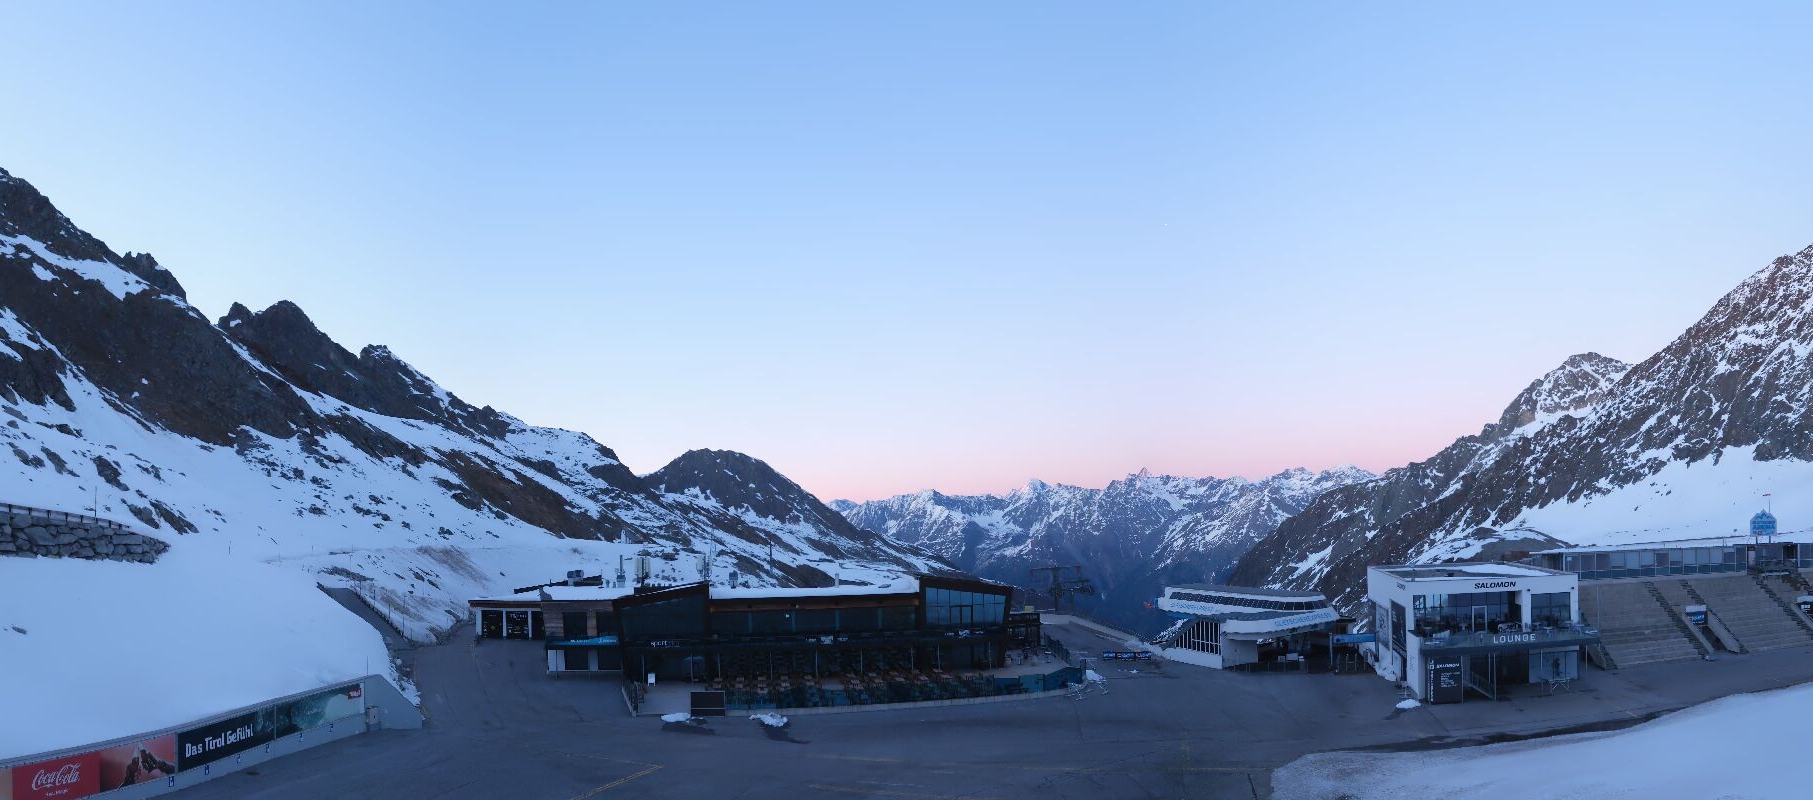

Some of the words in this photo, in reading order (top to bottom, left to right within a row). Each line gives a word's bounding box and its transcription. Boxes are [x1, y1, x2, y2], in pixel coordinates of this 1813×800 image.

[1474, 581, 1516, 589] SALOMON
[1493, 633, 1536, 644] LOUNGE
[185, 743, 203, 758] Das
[204, 736, 225, 751] Tirol
[226, 723, 254, 745] Gefühl
[31, 763, 81, 791] Coca-Cola
